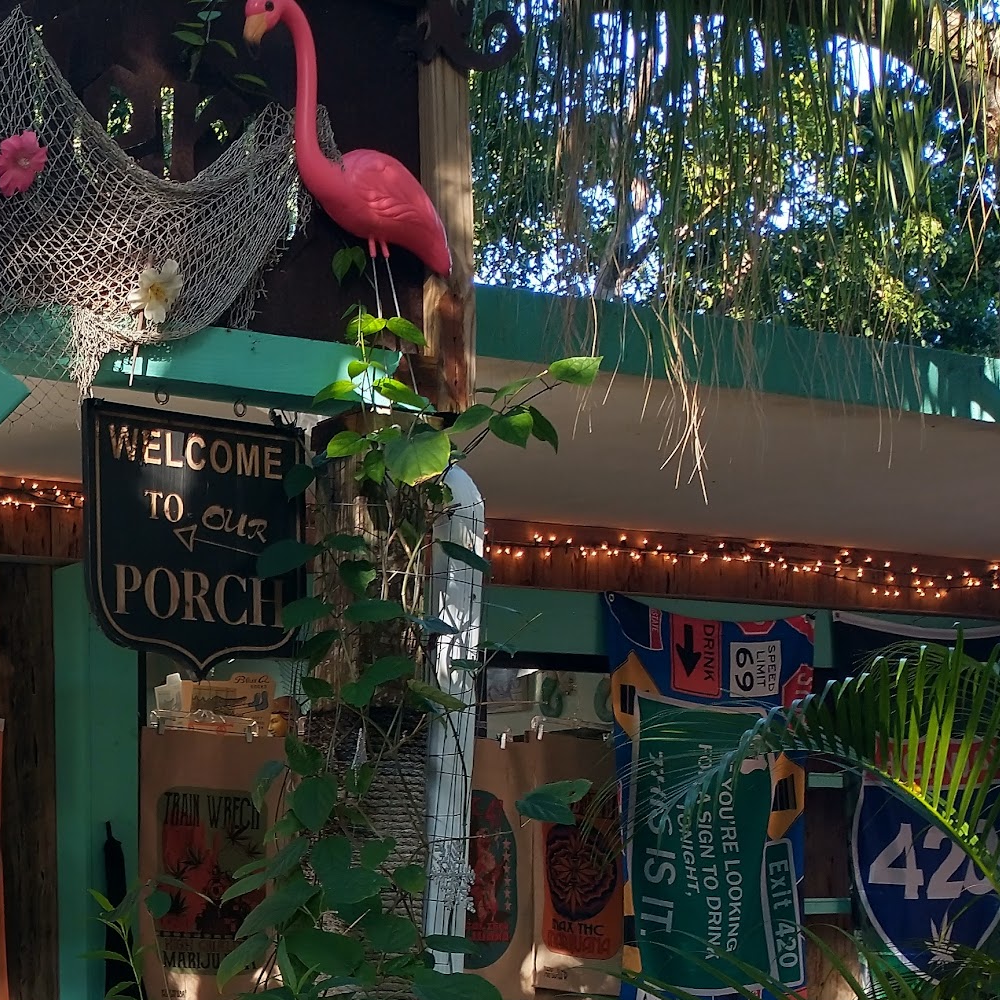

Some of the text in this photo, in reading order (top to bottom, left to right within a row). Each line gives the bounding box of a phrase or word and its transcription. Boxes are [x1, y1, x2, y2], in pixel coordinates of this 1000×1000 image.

[109, 423, 283, 480] WELCOME
[145, 490, 184, 522] TO
[113, 563, 285, 628] PORCH
[702, 624, 715, 681] DRINK
[734, 647, 754, 692] 69
[756, 651, 766, 687] LIMIT
[768, 645, 776, 692] SPEED
[164, 792, 200, 826] TRAIN
[698, 811, 715, 858] SIGN
[643, 848, 676, 886] IS
[702, 865, 719, 890] TO
[719, 778, 743, 952] YOU'RE LOOKING
[578, 922, 604, 936] THC
[640, 896, 674, 936] IT.
[768, 860, 799, 969] Exit 420
